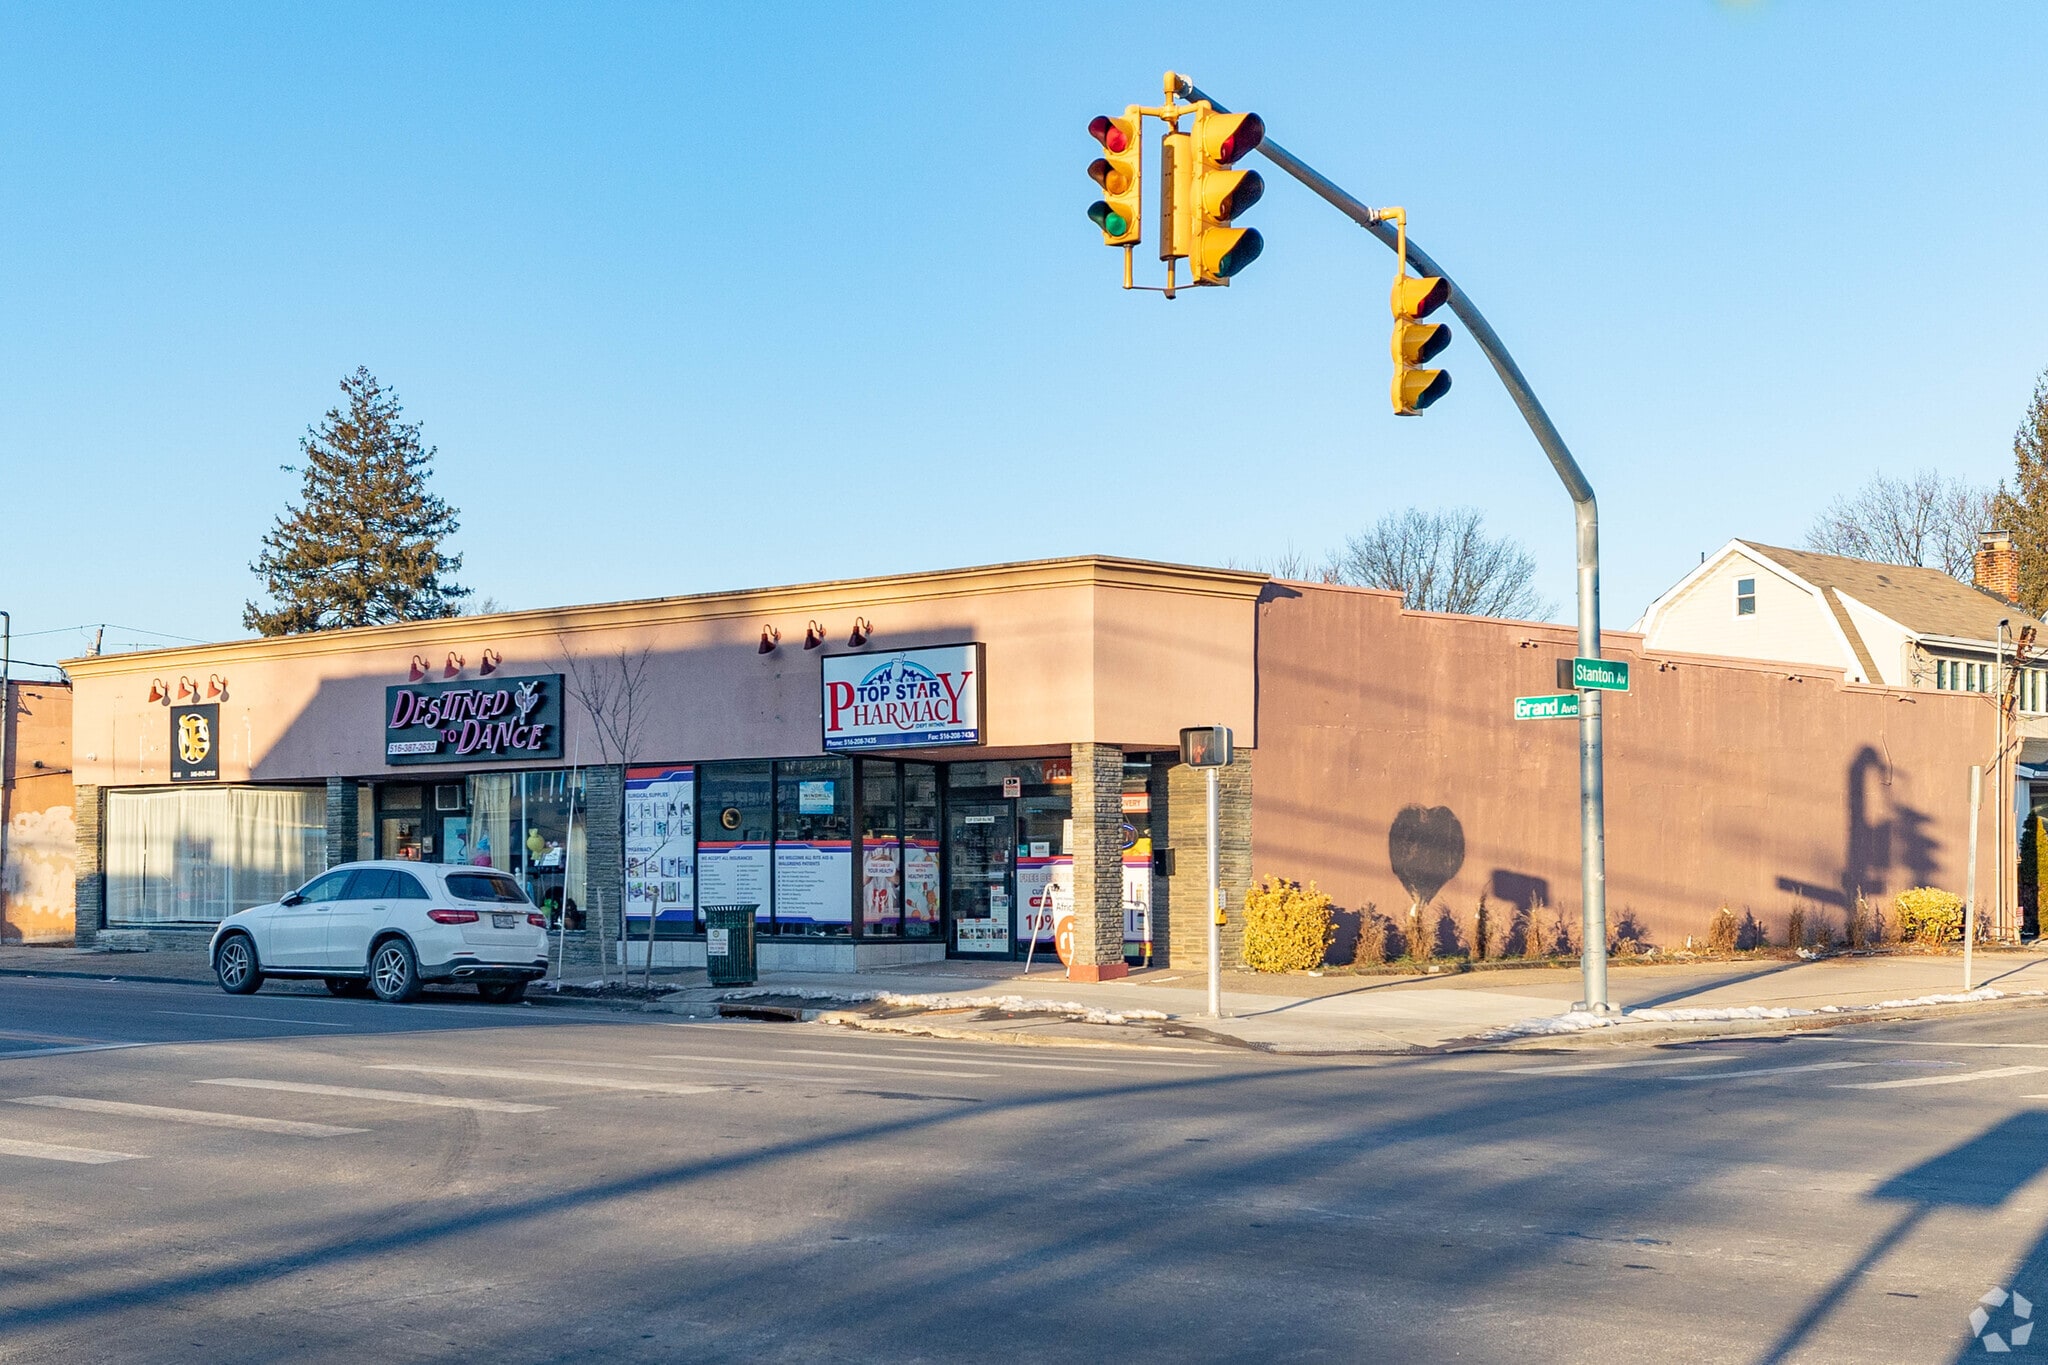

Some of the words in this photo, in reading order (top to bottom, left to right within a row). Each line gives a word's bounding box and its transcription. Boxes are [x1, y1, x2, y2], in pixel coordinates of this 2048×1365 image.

[1576, 664, 1614, 683] Stanton
[1617, 672, 1626, 684] Av
[826, 671, 973, 732] PHARMACY
[857, 686, 890, 702] TOP
[896, 682, 940, 700] STAR
[388, 689, 509, 729] DESTINED
[1517, 699, 1558, 717] Grand
[1561, 703, 1577, 714] Ave
[440, 729, 457, 743] TO
[455, 715, 545, 755] DANCE
